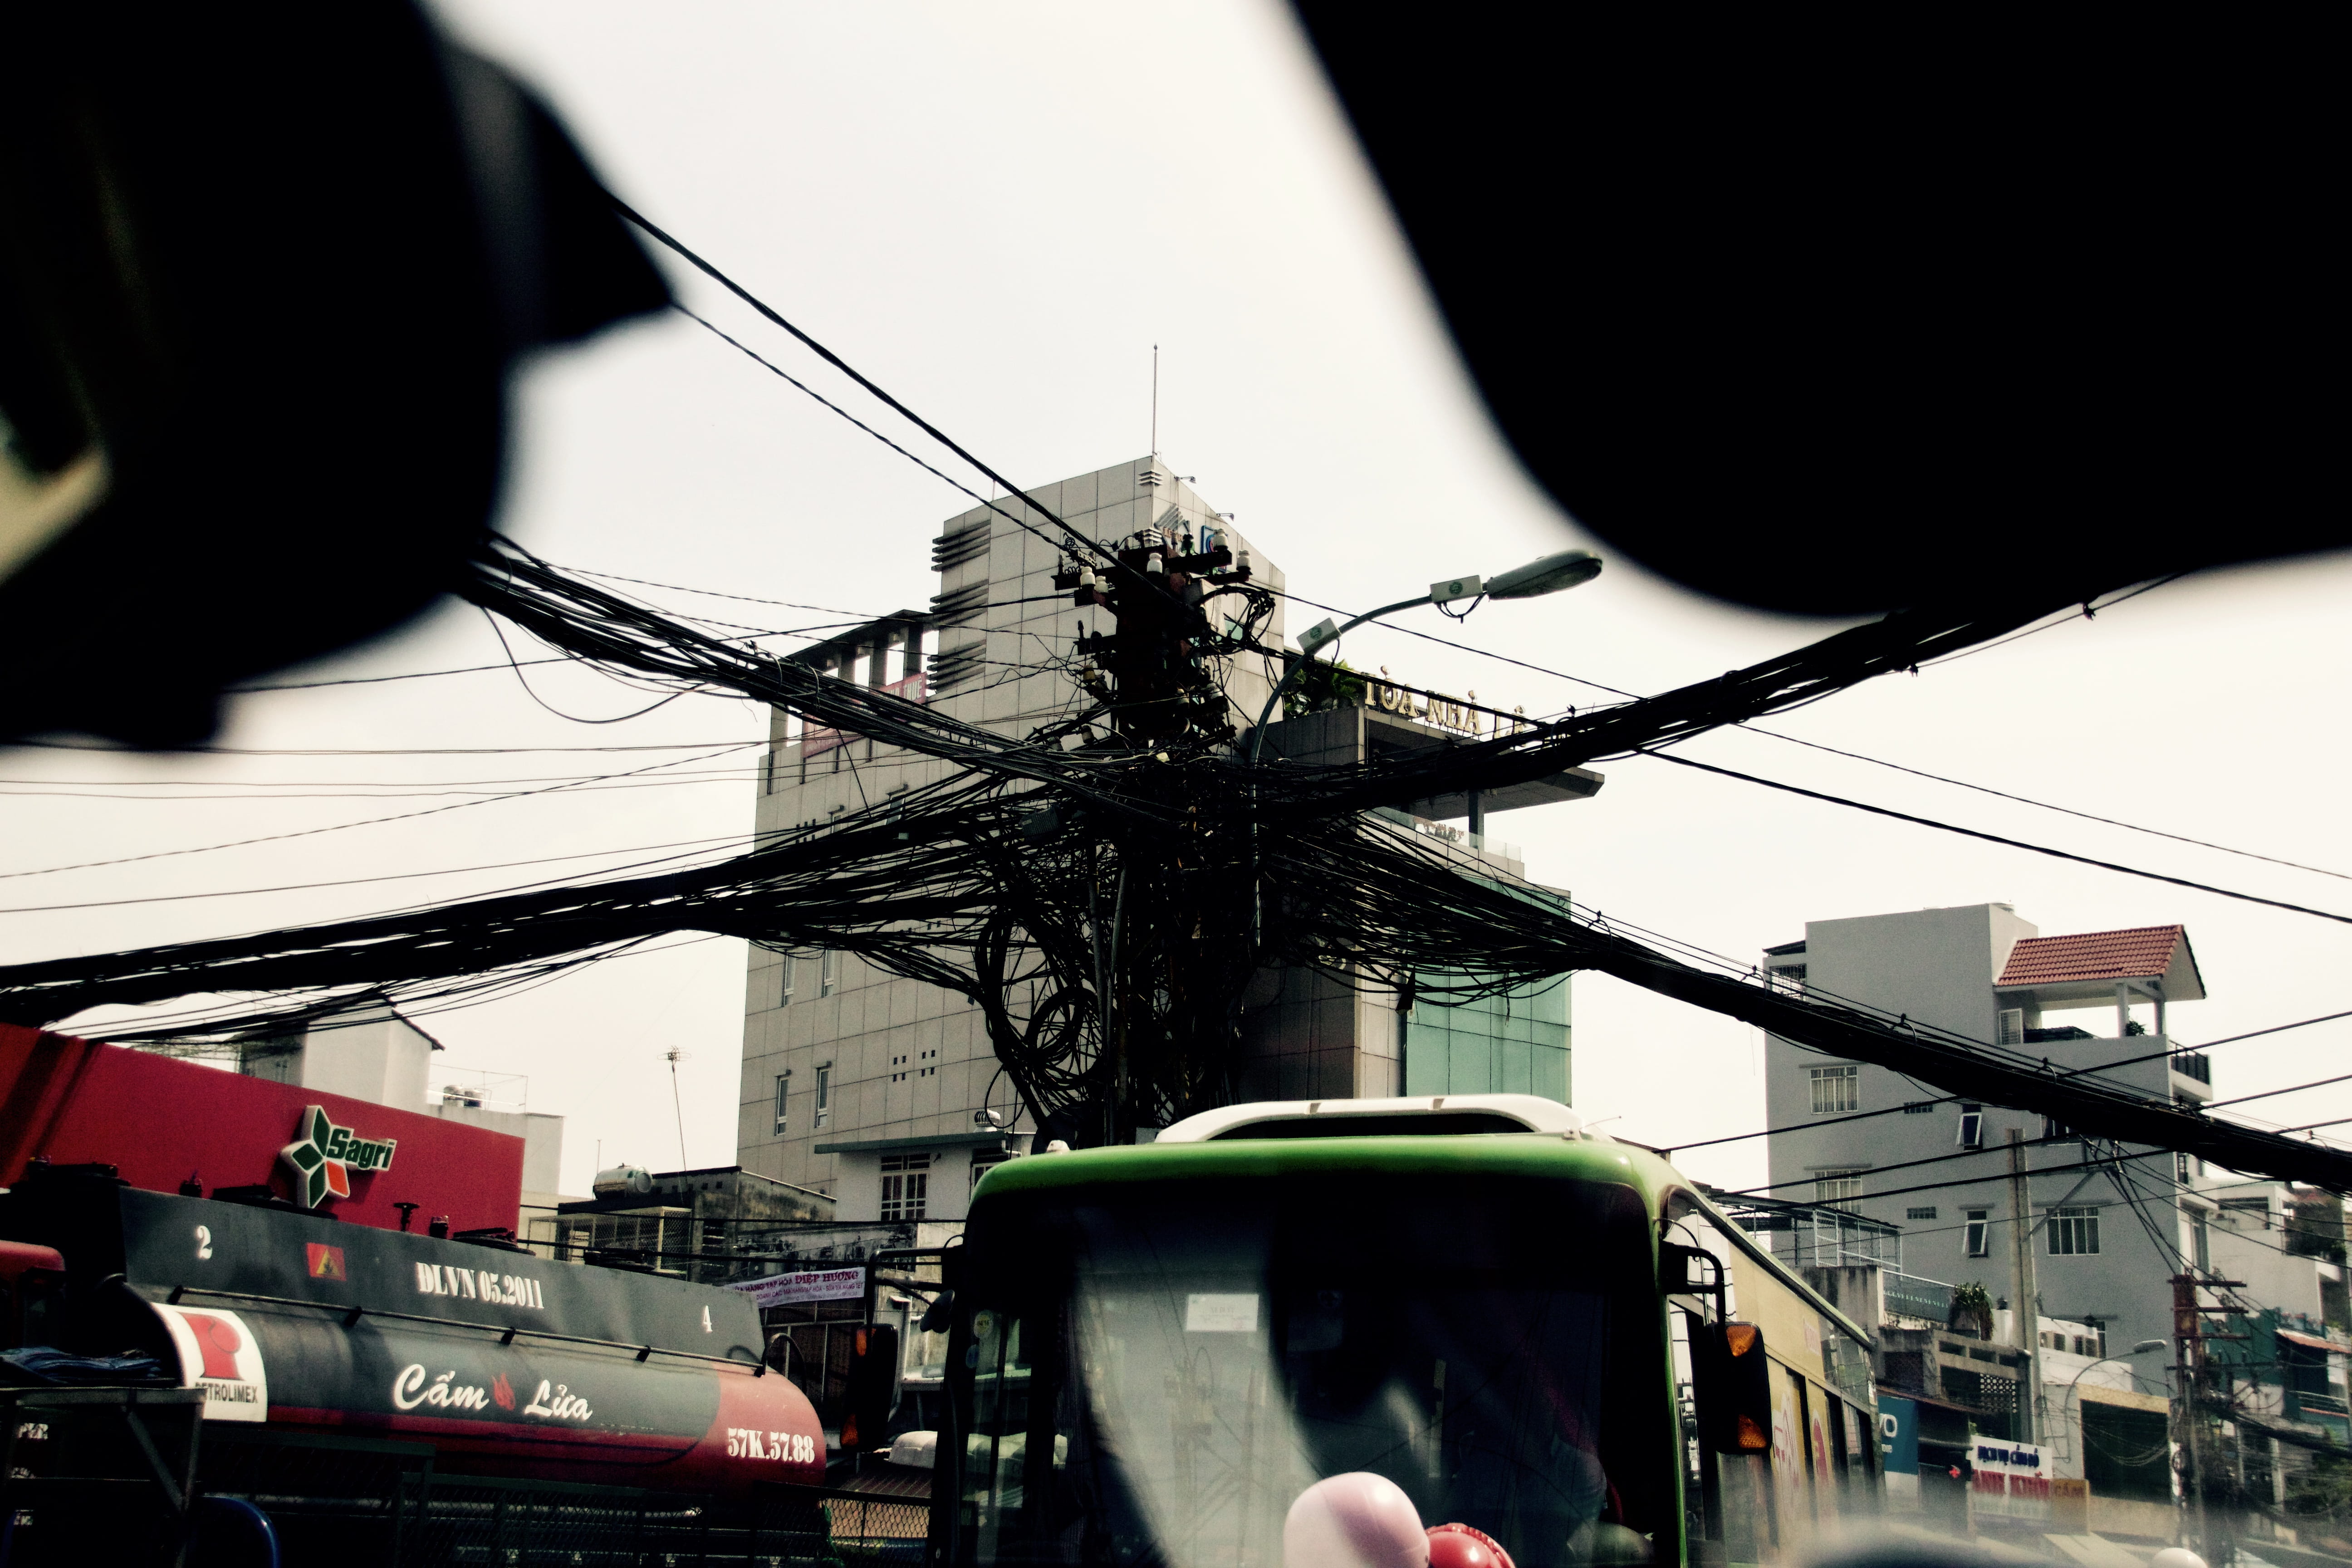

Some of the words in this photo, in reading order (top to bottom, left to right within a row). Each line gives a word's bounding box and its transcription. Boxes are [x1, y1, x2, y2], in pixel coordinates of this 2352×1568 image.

[326, 1128, 395, 1168] Sagri
[195, 1225, 213, 1259] 2
[479, 1271, 544, 1309] 05.2011
[703, 1305, 713, 1332] 4
[394, 1363, 490, 1410] Cấm
[524, 1379, 593, 1421] Lửa
[728, 1427, 815, 1463] 57K.57.88
